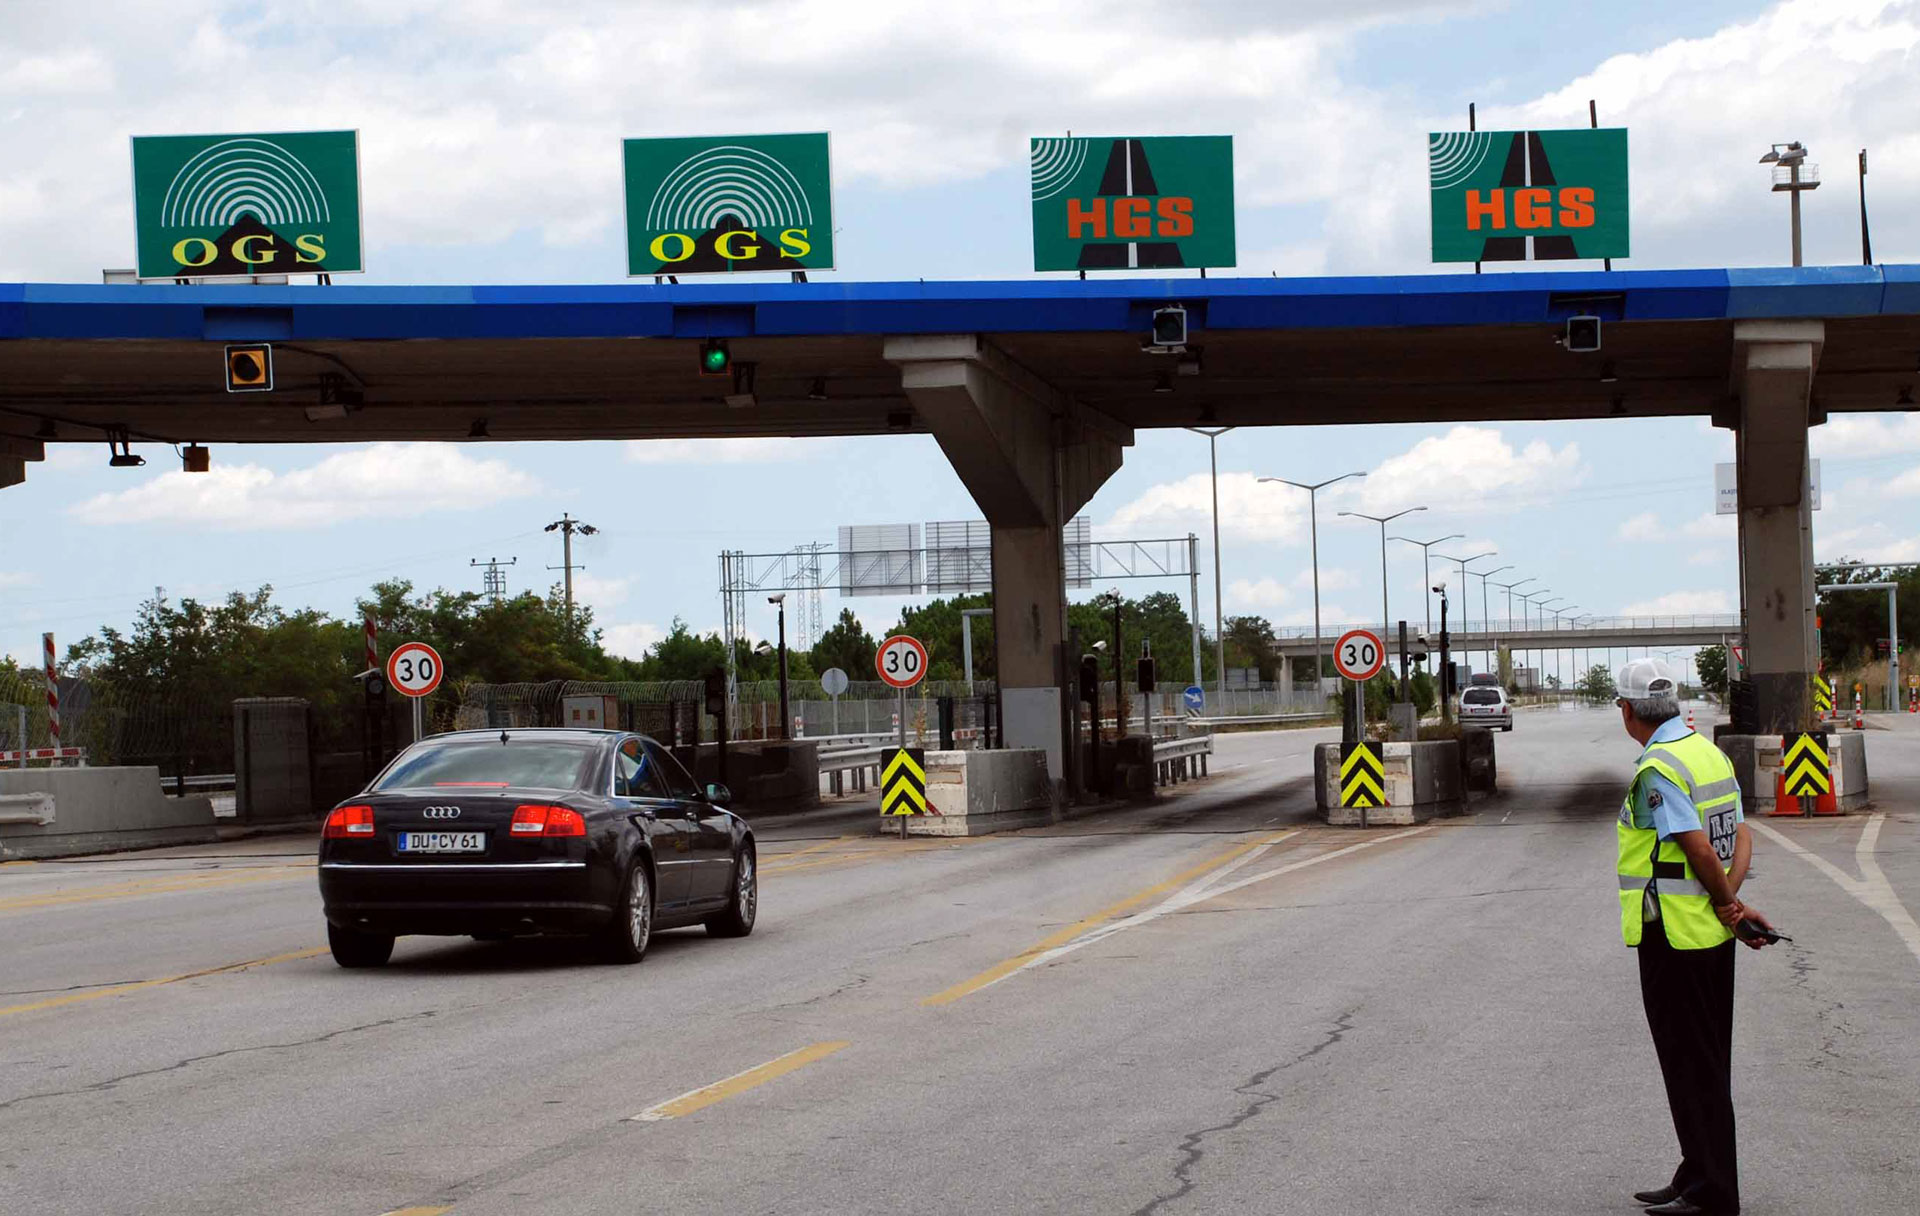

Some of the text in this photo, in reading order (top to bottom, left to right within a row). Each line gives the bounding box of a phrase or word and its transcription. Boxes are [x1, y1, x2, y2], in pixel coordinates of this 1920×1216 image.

[1067, 196, 1194, 239] HGS
[1465, 187, 1595, 230] HGS
[172, 234, 327, 266] OGS
[650, 228, 811, 262] OGS
[886, 650, 917, 673] 30
[1344, 643, 1375, 667] 30
[400, 658, 433, 682] 30
[411, 834, 479, 848] DU CY 61
